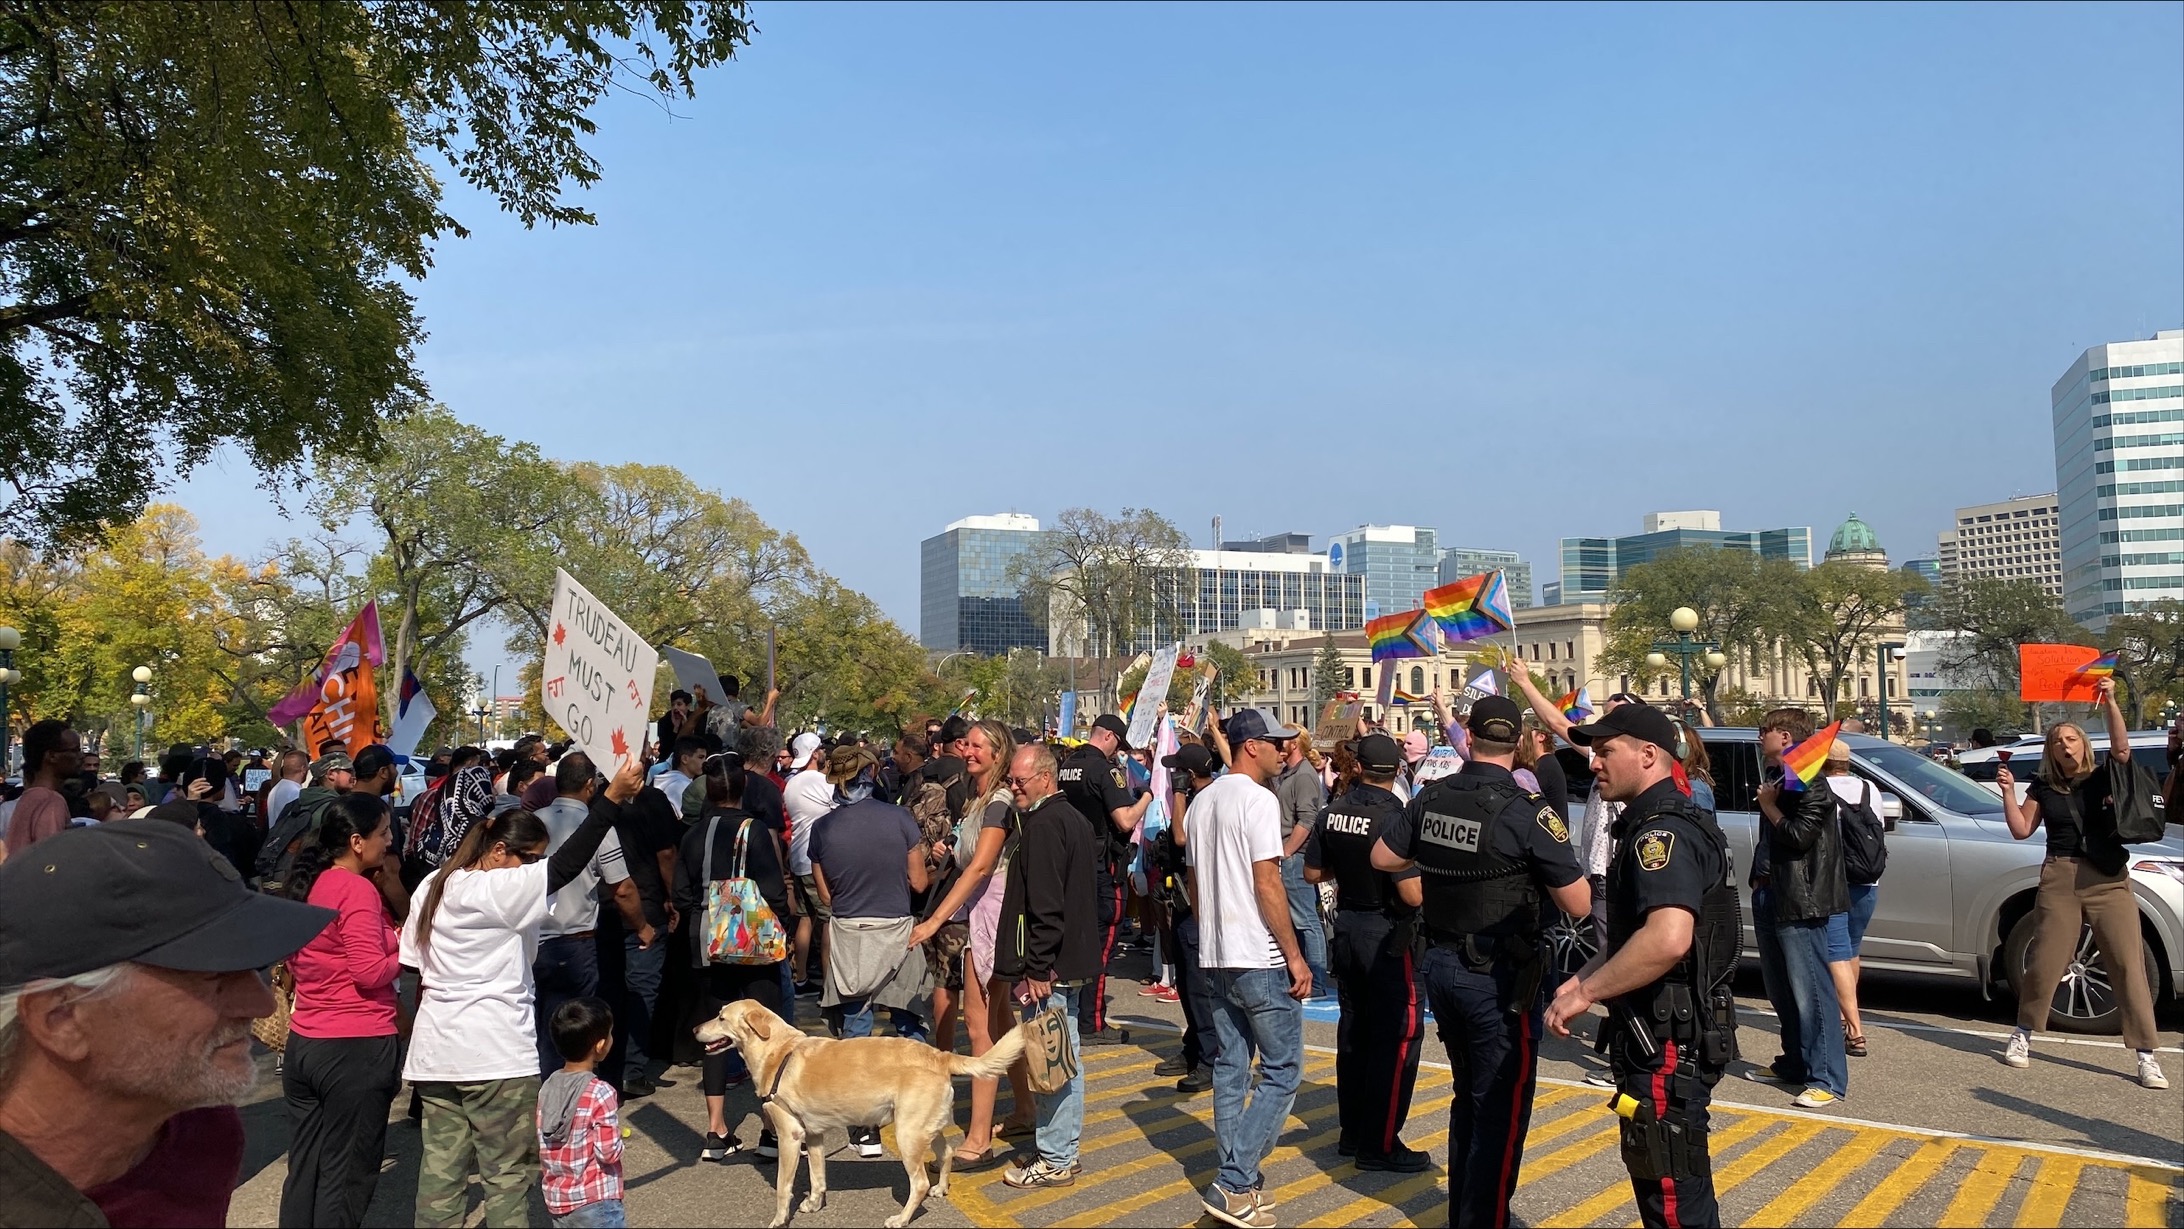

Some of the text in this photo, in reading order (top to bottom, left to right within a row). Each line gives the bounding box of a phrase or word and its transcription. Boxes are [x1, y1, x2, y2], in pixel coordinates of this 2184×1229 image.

[567, 588, 637, 673] TRUDEAU
[547, 676, 565, 699] FJT
[568, 649, 616, 714] MUST
[626, 679, 643, 709] FJT
[567, 703, 593, 746] GO
[1058, 768, 1083, 781] POLICE
[1326, 813, 1372, 836] POLICE
[1422, 818, 1479, 846] POLICE
